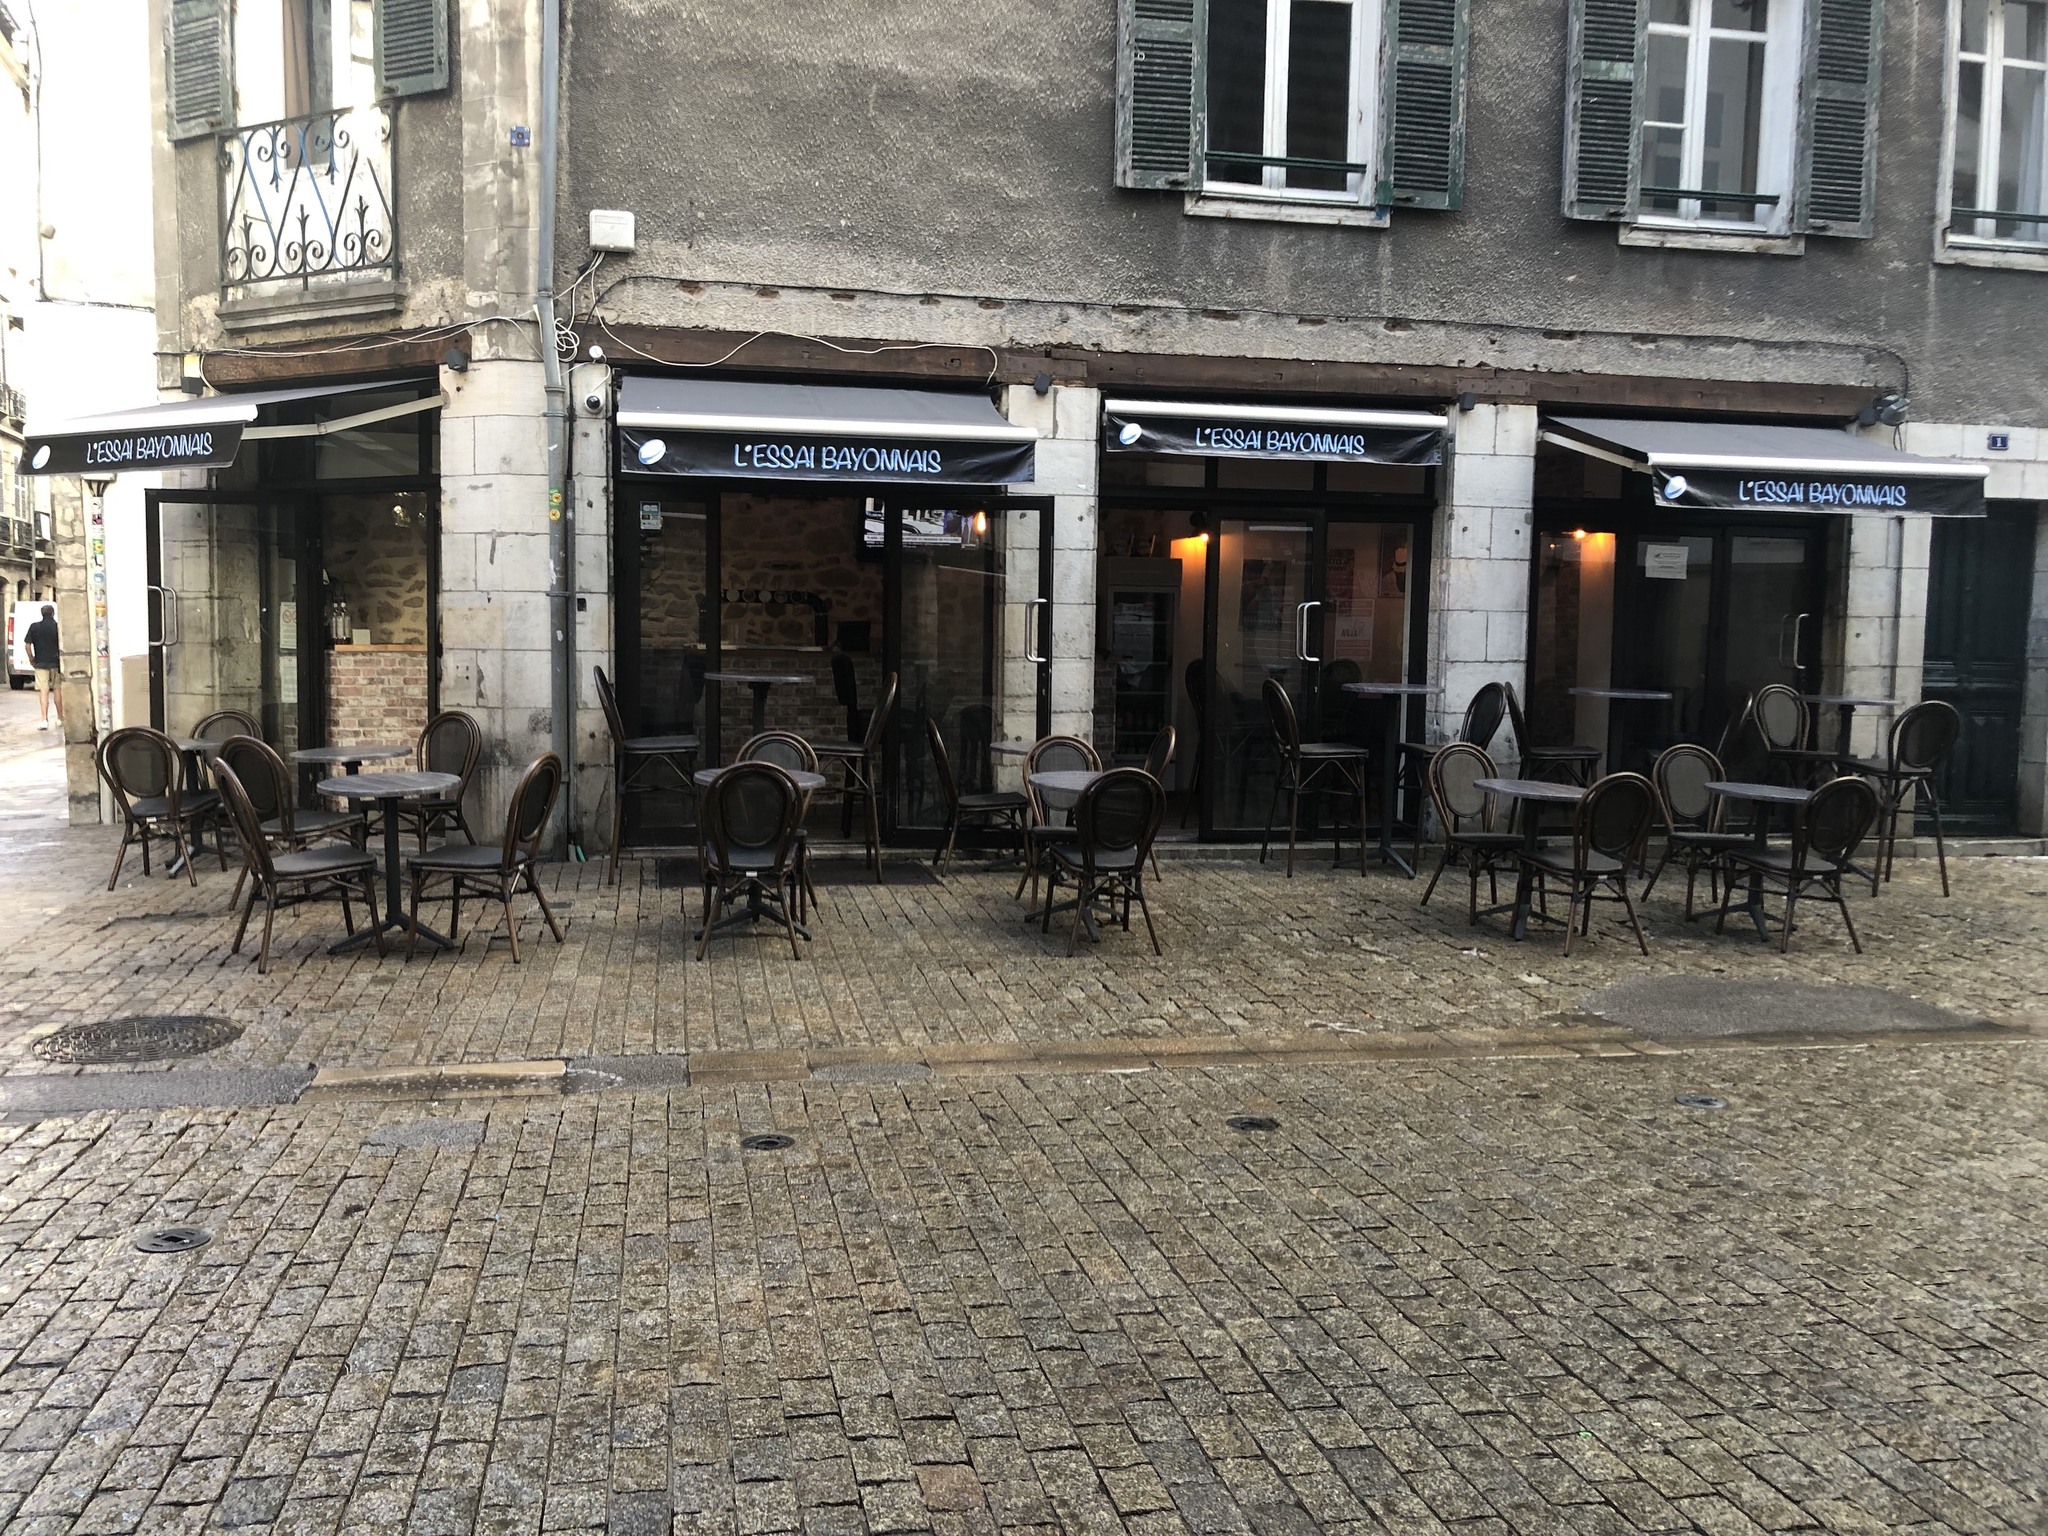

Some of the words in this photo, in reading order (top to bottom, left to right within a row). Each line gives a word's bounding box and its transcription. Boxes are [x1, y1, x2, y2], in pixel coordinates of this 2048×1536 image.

[86, 440, 133, 464] L'ESSAI
[136, 432, 213, 460] BAYONNAIS
[1195, 427, 1262, 450] L'ESSAI
[1266, 431, 1365, 455] BAYONNAIS
[733, 443, 815, 469] L'ESSAI
[821, 445, 942, 474] BAYONNAIS
[1739, 480, 1804, 503] L'ESSAI
[1809, 483, 1906, 507] BAYONNAIS
